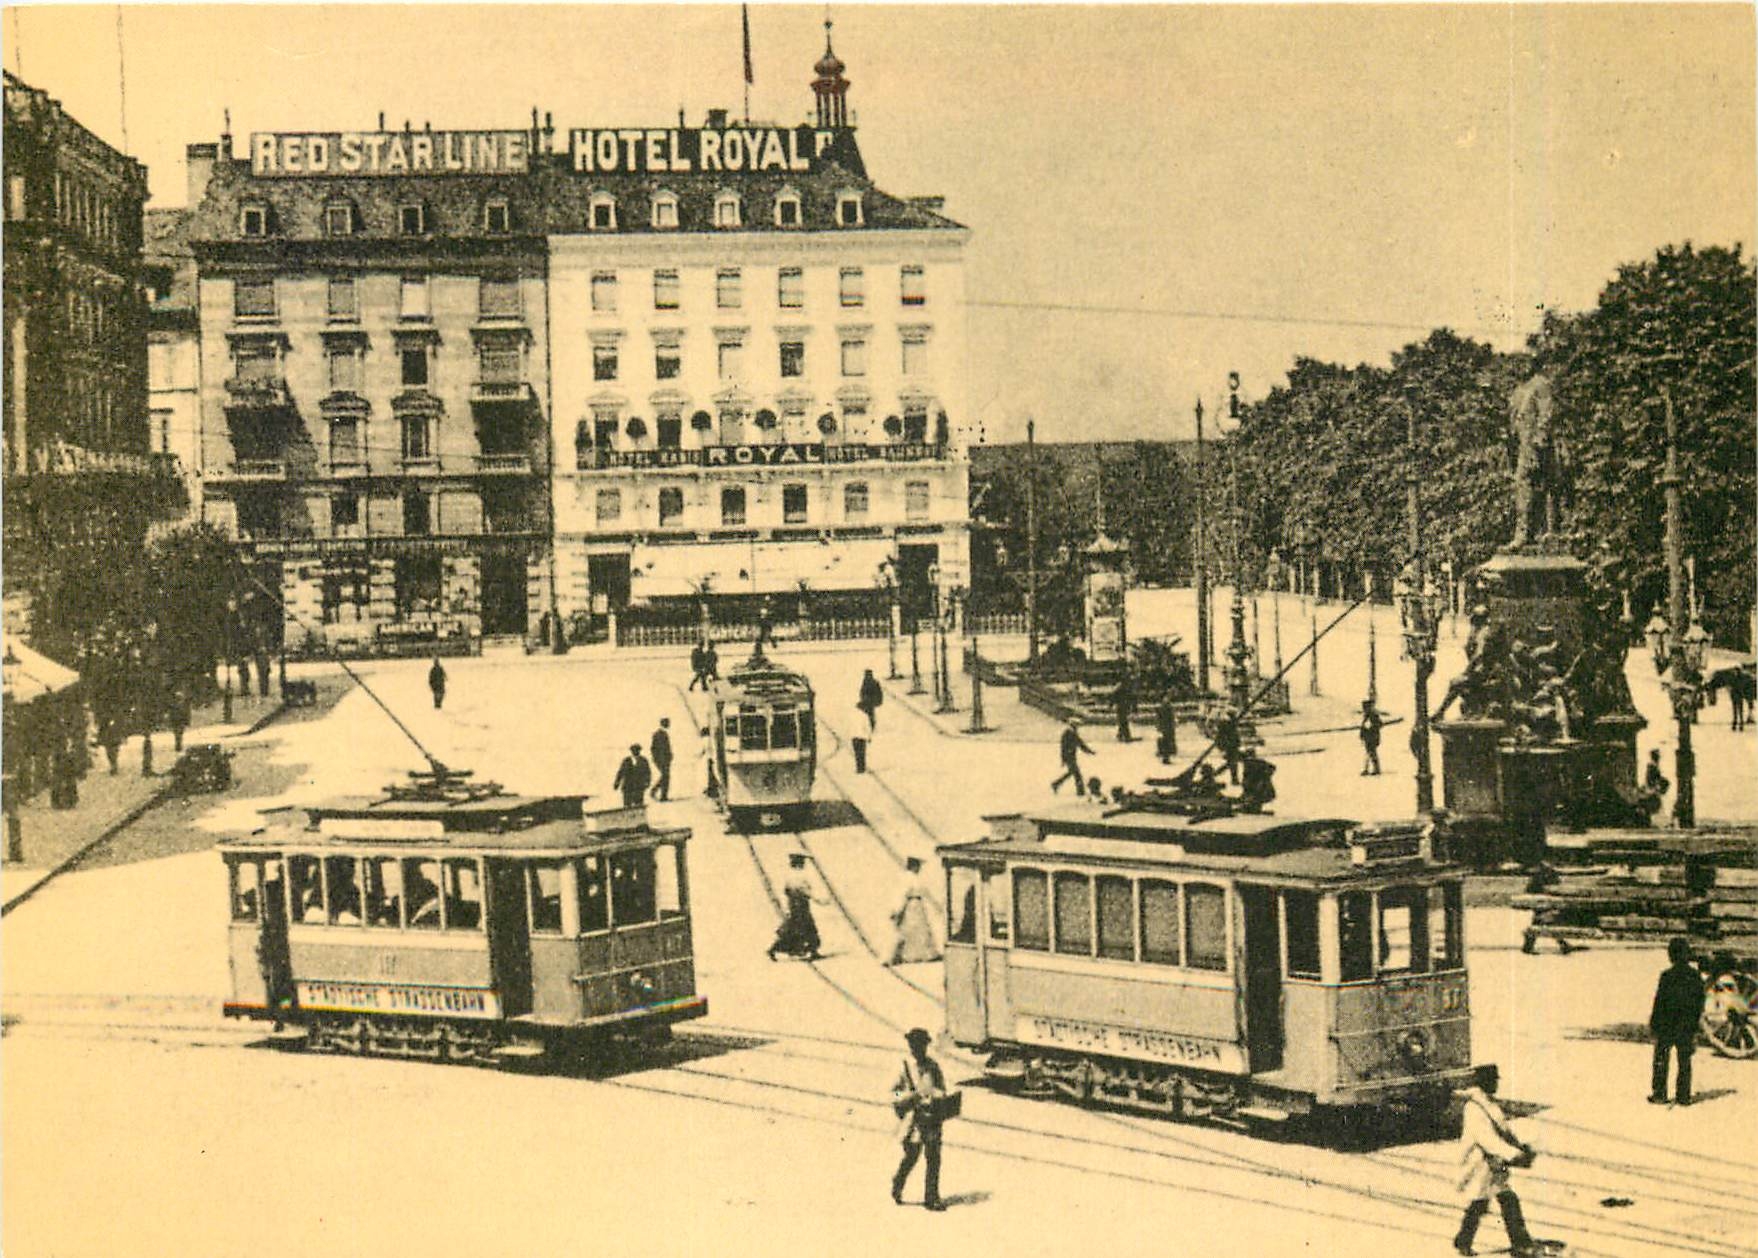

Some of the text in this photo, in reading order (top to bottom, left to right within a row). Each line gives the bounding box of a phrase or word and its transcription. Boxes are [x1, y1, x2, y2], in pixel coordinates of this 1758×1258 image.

[256, 132, 524, 173] RED STAR LINE
[574, 130, 691, 172] HOTEL
[700, 129, 809, 171] ROYAL
[708, 445, 820, 465] ROYAL
